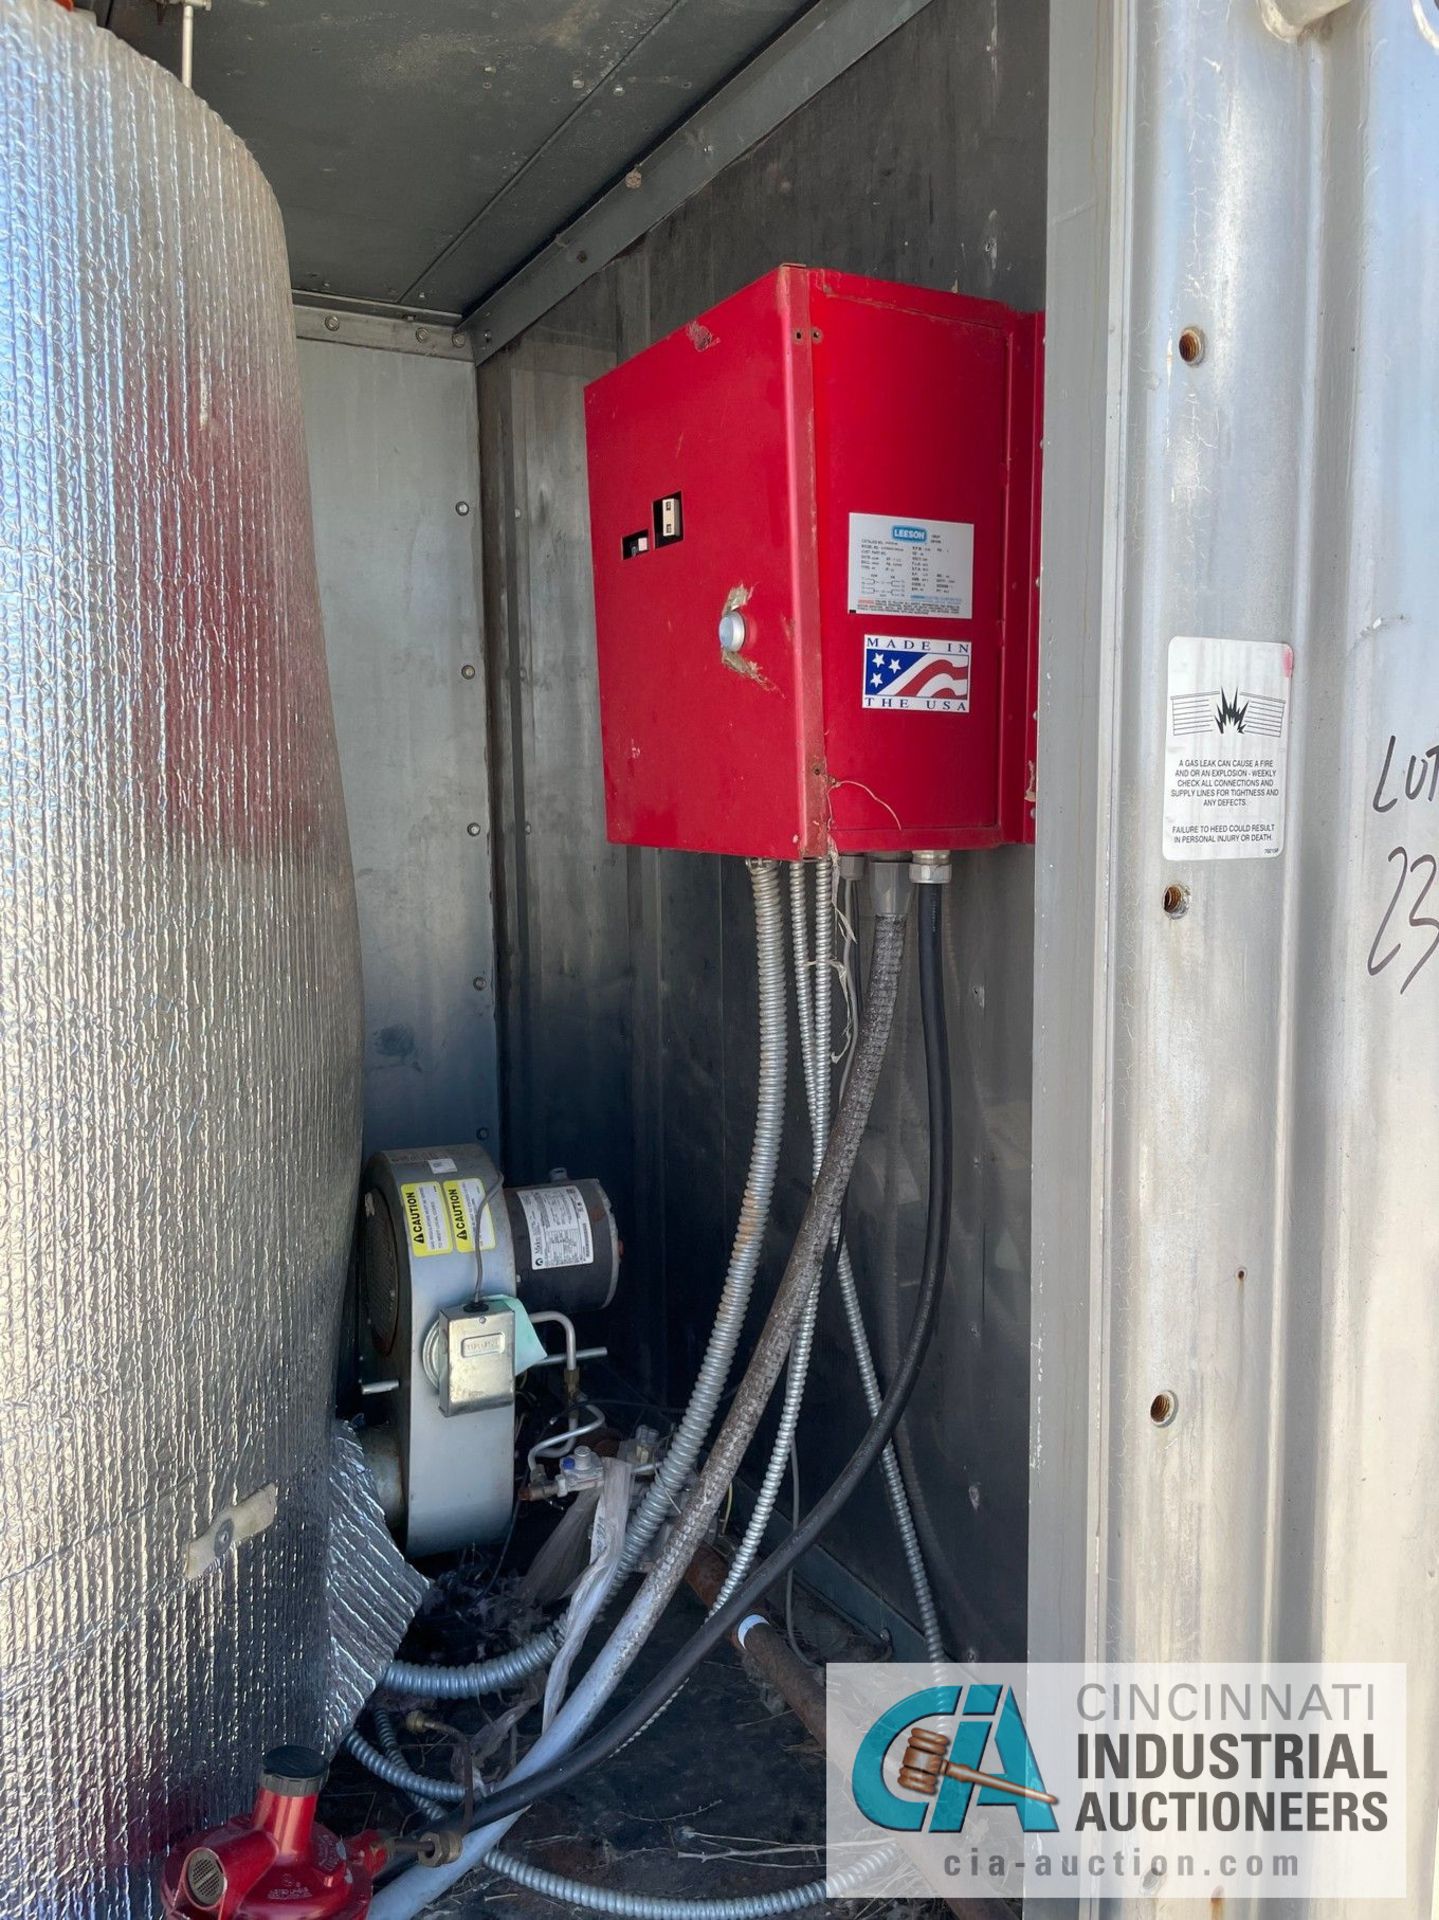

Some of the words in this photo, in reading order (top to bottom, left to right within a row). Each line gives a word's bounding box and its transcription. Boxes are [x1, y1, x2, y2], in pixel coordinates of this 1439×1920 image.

[894, 529, 925, 540] LEESON
[867, 638, 931, 651] MADE
[948, 642, 969, 653] IN
[865, 697, 909, 708] THE
[926, 700, 966, 711] USA
[1171, 789, 1196, 797] SUPPLY
[1196, 789, 1215, 797] LINES
[1216, 789, 1229, 797] FOR
[1231, 789, 1265, 797] TIGHTNESS
[1266, 789, 1279, 797] AND
[1200, 825, 1209, 833] TO
[1251, 824, 1275, 832] RESULT
[1182, 835, 1216, 843] PERSONAL
[1240, 834, 1250, 842] OR
[406, 1192, 422, 1232] CAUTION
[448, 1189, 465, 1229] CAUTION
